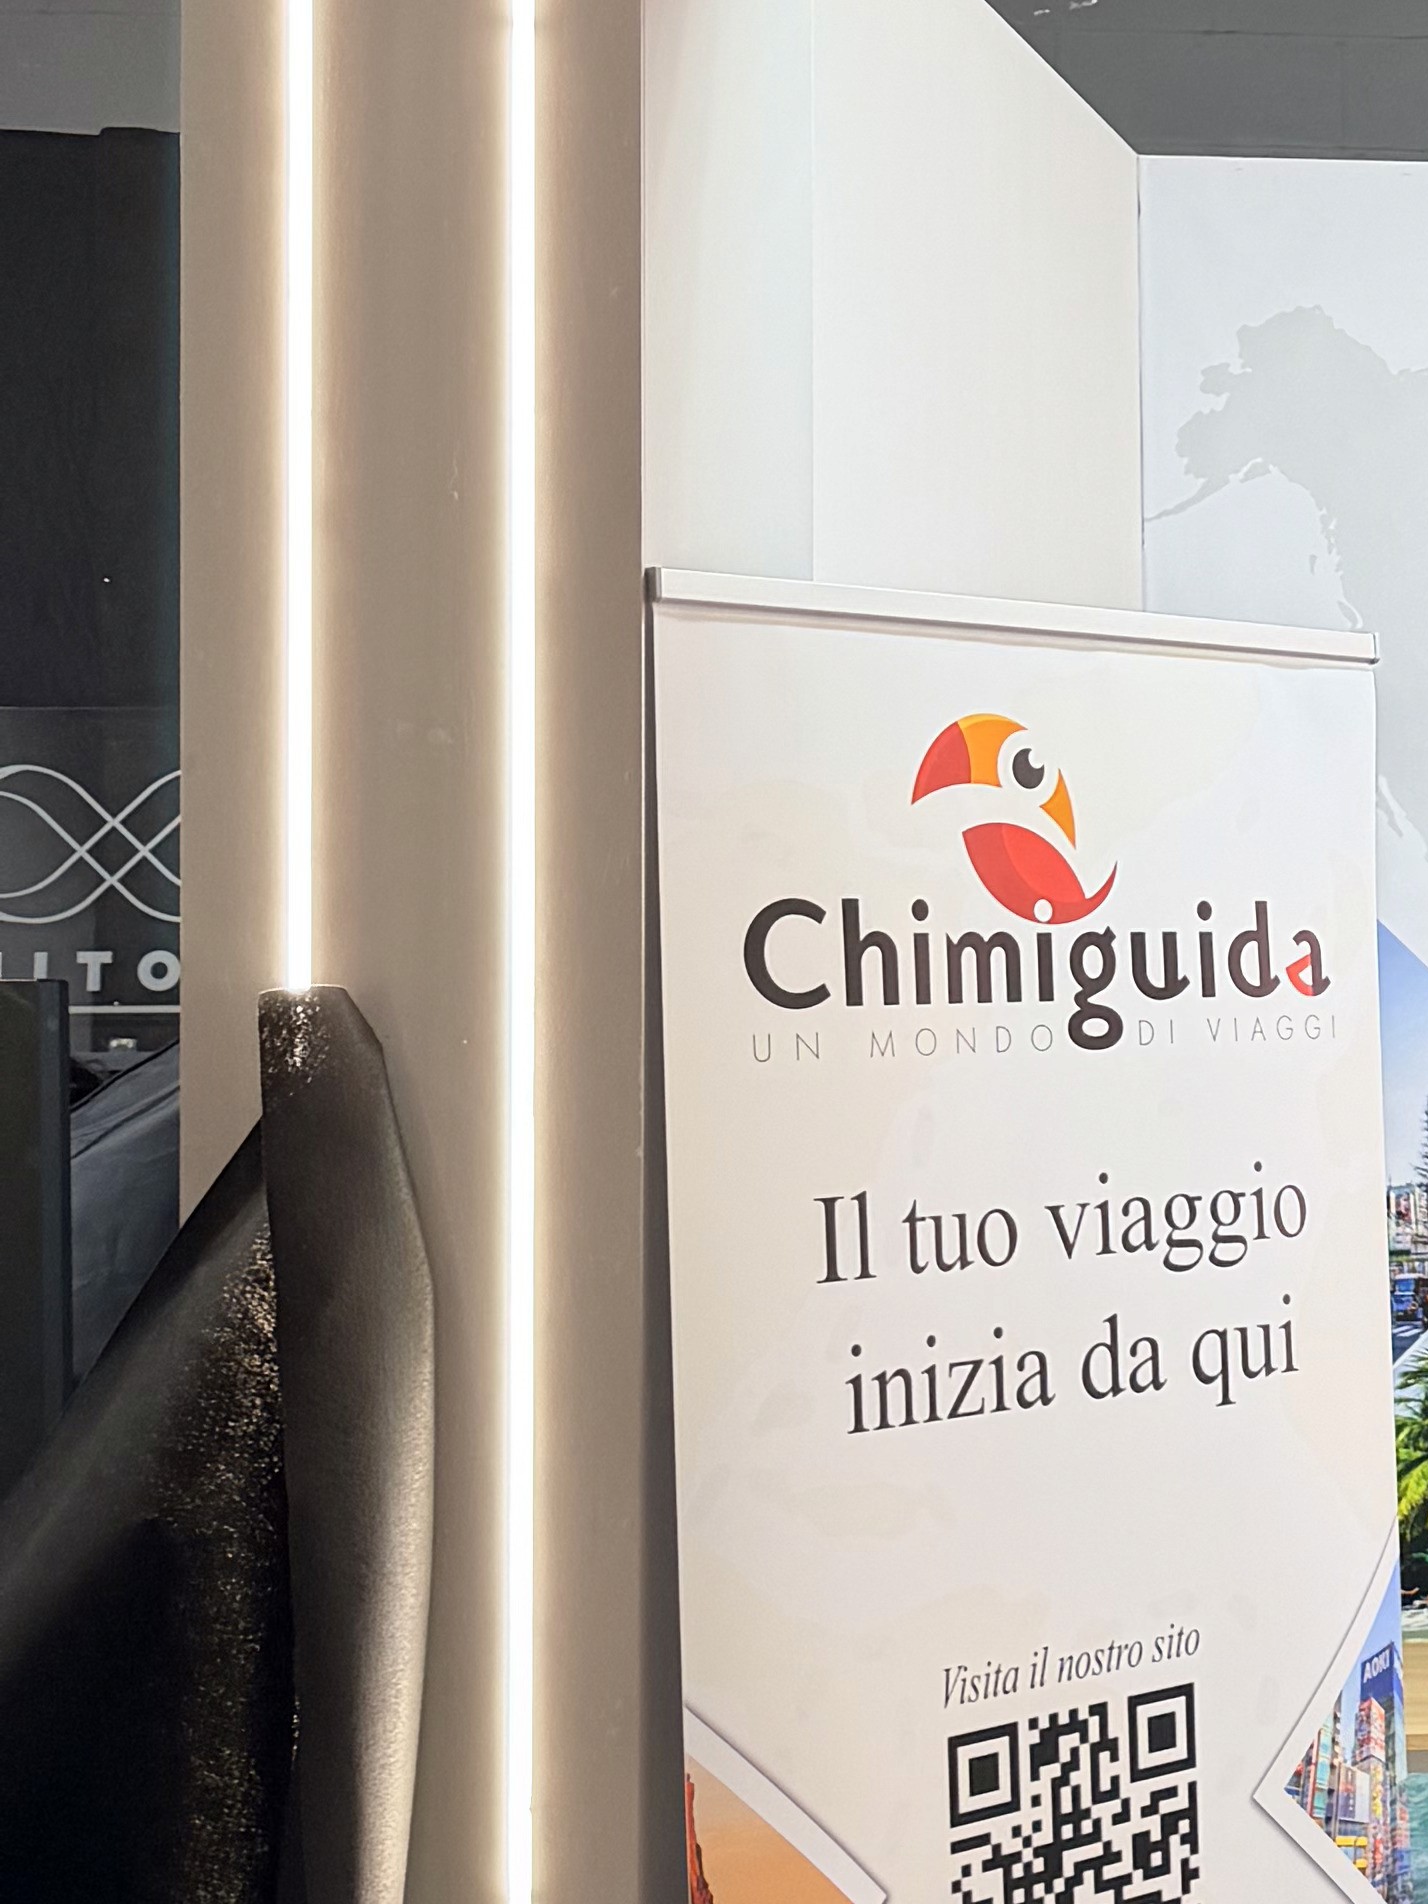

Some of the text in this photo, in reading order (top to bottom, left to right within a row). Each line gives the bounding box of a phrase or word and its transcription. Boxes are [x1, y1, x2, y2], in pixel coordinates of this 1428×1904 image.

[0, 951, 181, 992] ITO
[743, 897, 1331, 1050] Chimiguida
[752, 1015, 1336, 1063] UN MONDO DI VIAGGI
[813, 1160, 1308, 1284] Il tuo viaggio
[845, 1293, 1300, 1435] inizia da qui
[942, 1623, 1201, 1709] Visita il nostro sito
